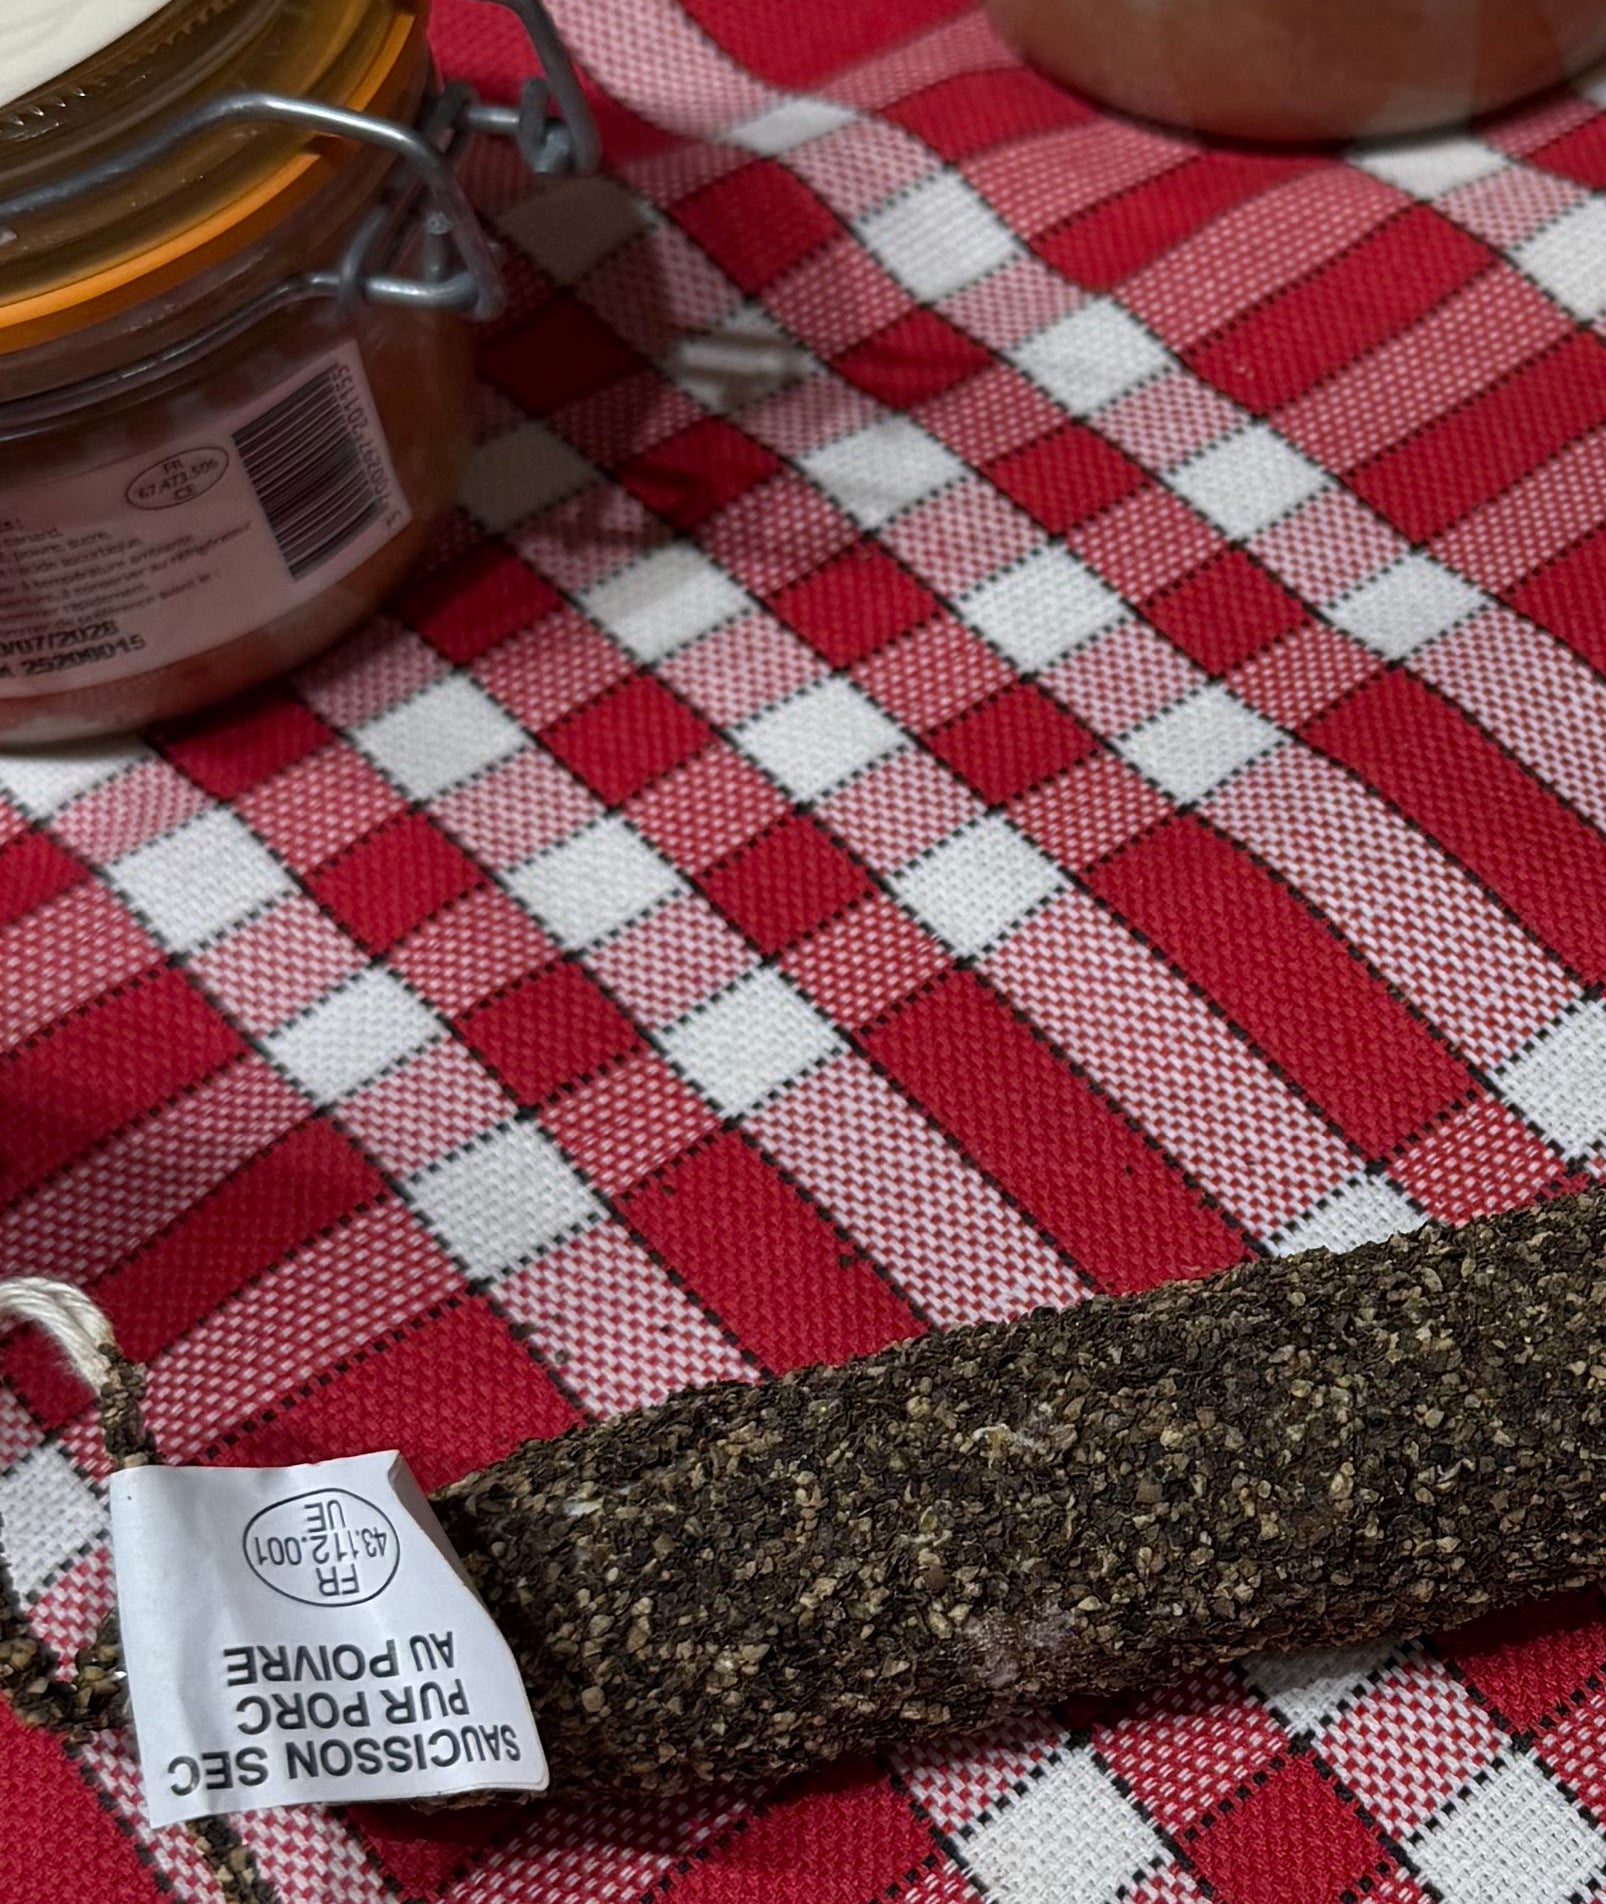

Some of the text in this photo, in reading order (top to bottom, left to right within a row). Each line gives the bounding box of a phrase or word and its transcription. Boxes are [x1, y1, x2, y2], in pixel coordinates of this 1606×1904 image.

[305, 1499, 345, 1529] UE
[253, 1526, 389, 1566] 43.112.001
[318, 1563, 359, 1597] FR
[222, 1631, 455, 1688] AU POIVRE
[235, 1677, 471, 1735] PUR PORC
[167, 1723, 522, 1798] SAUCISSON SEC
